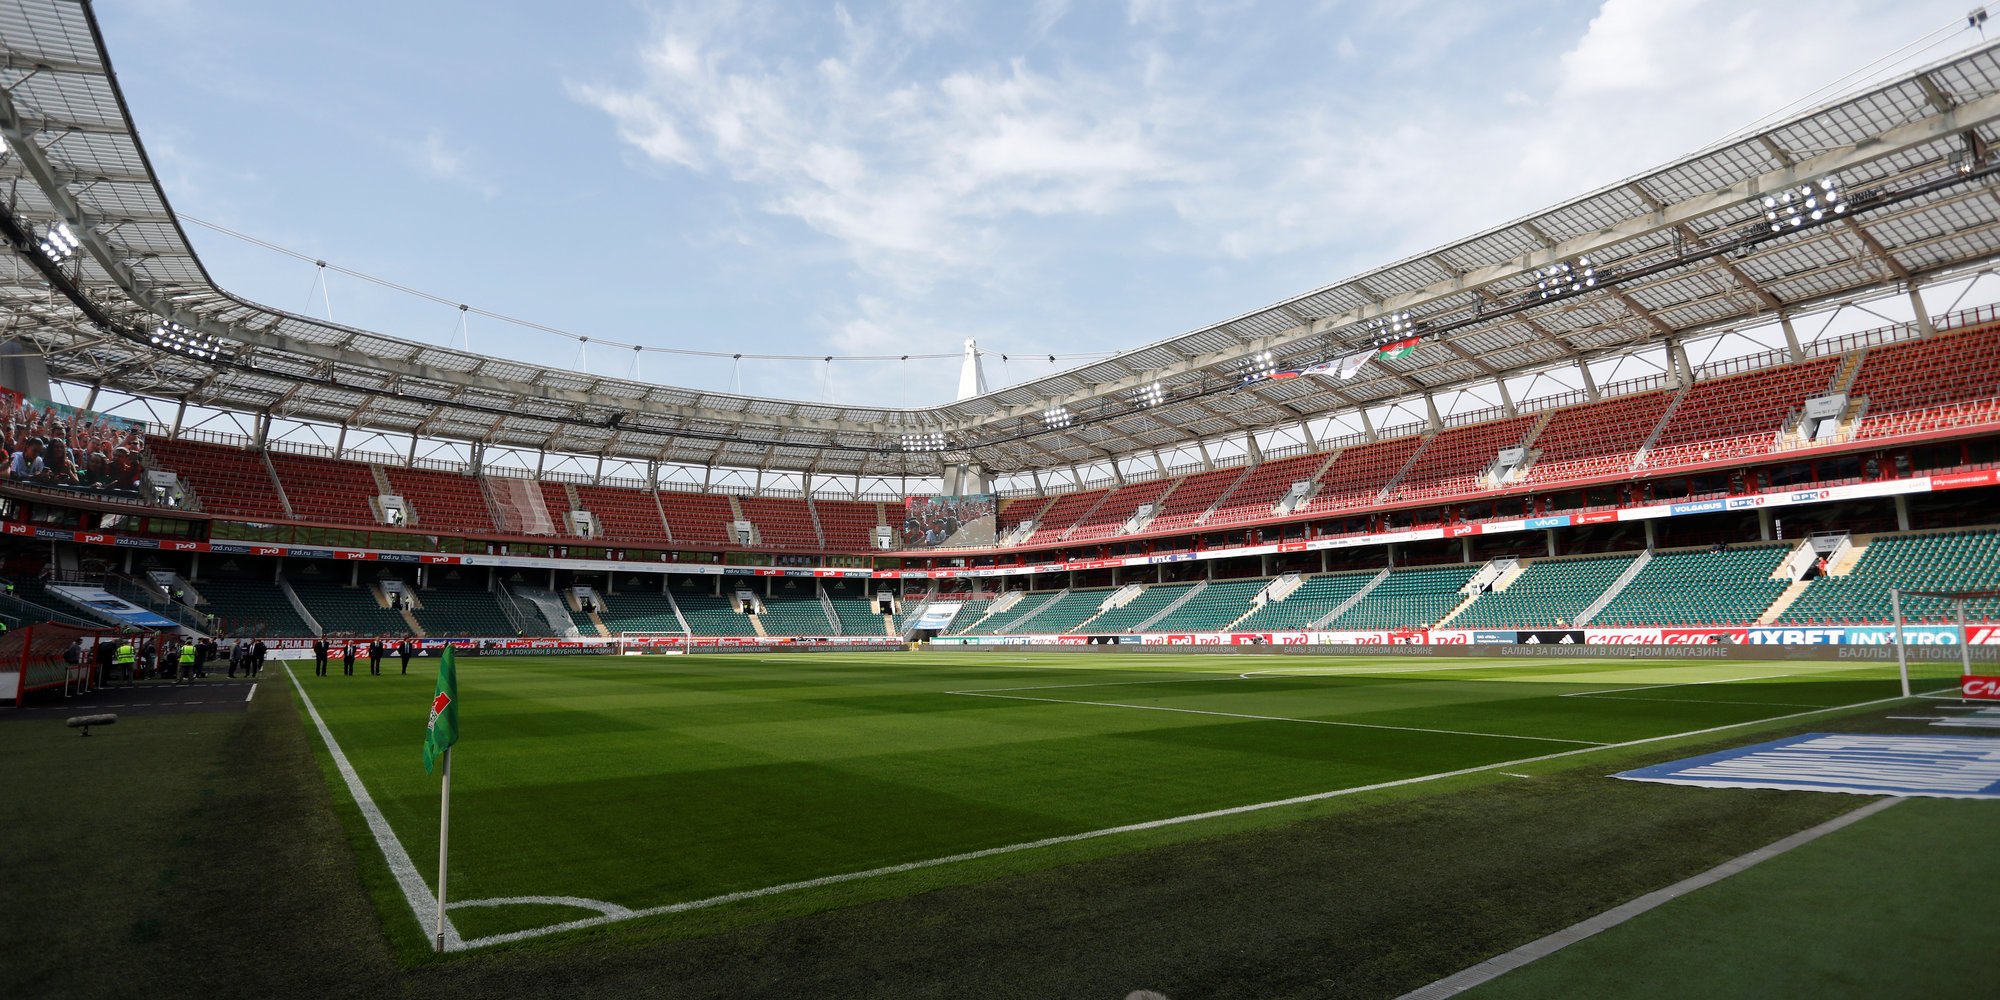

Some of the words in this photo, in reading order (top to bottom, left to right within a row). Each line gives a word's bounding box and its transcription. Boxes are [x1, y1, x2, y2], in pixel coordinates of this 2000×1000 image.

[1674, 503, 1723, 513] VOLGABUS
[1663, 632, 1742, 645] САПСН
[1749, 630, 1844, 645] 1XBET
[1850, 632, 1957, 645] INVTRO
[1502, 647, 1533, 656] БАЛЛЫ
[1550, 647, 1597, 656] ПОКУПКИ
[1609, 647, 1661, 656] КЛУБНОМ
[1665, 647, 1727, 656] МАГАЗИНЕ
[1839, 648, 1891, 658] БАЛЛЫ
